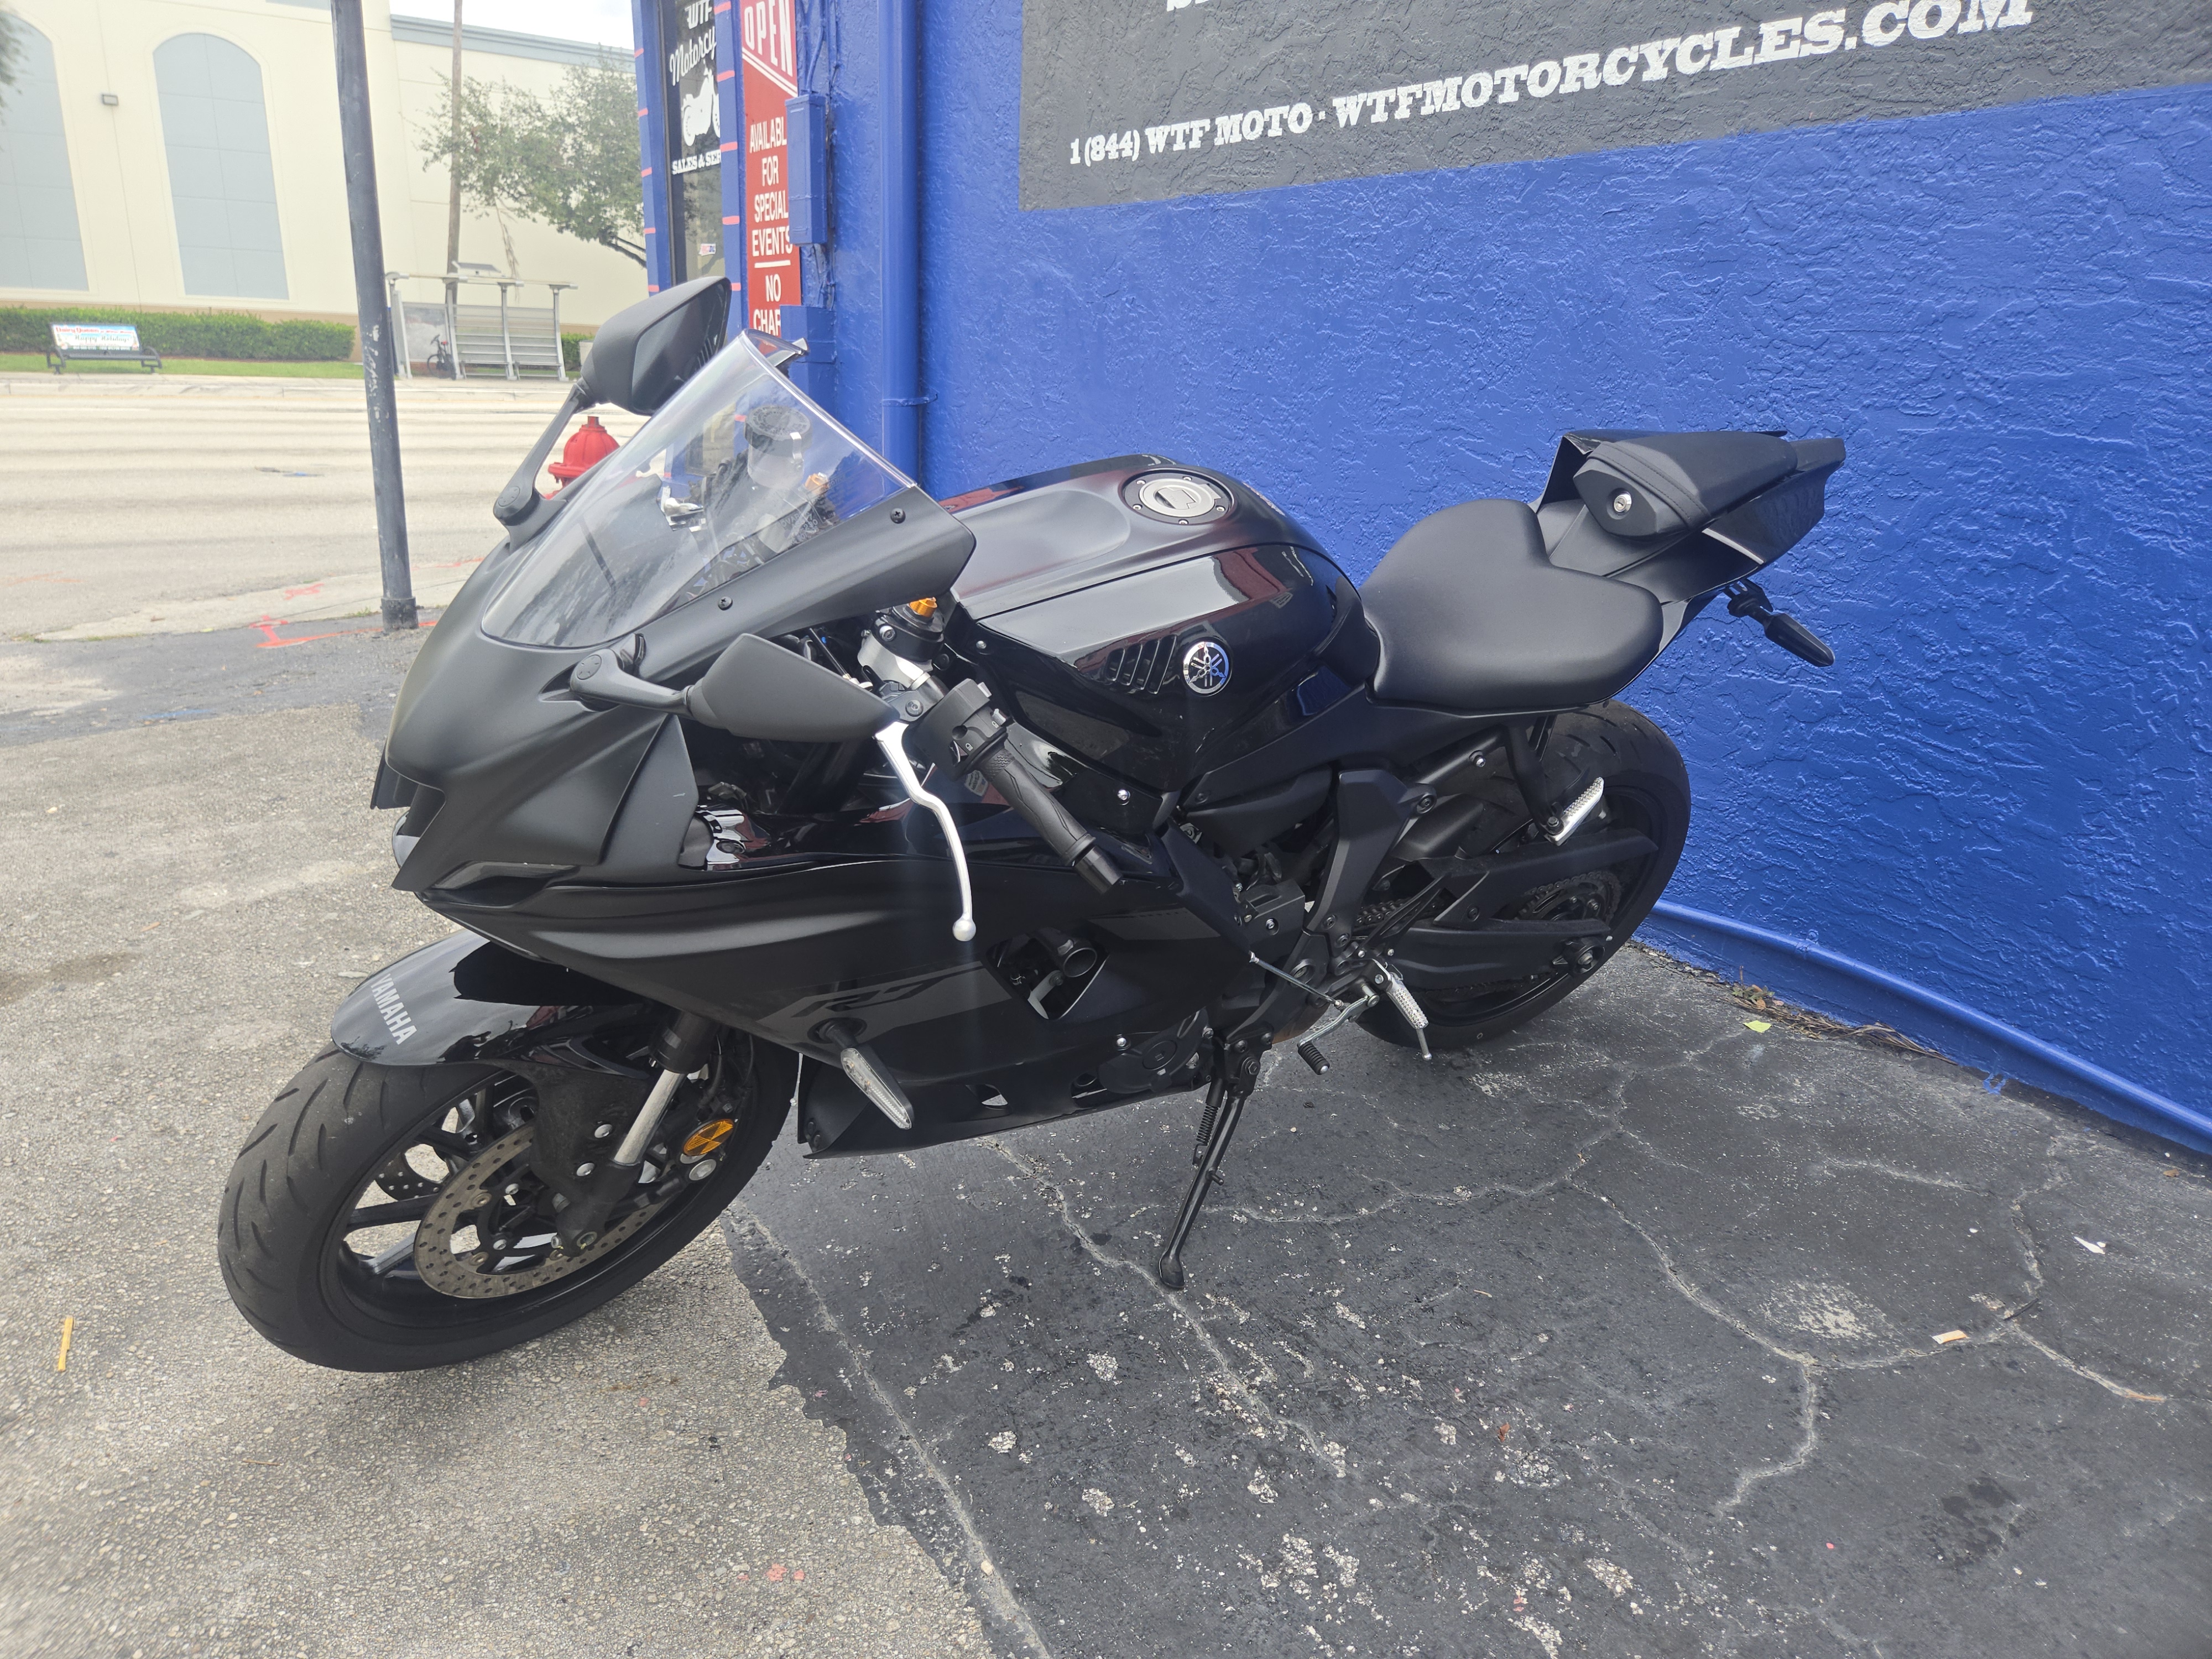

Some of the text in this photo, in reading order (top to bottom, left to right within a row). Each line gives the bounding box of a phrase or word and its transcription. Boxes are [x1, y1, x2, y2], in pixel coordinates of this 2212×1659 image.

[685, 0, 712, 29] WTF
[744, 0, 793, 77] OPEN
[1145, 119, 1211, 154] WTF
[1214, 103, 1313, 145] MOTO
[1332, 0, 2033, 128] WTFMOTORCYCLES.COM
[672, 155, 697, 175] SALES
[698, 154, 705, 169] &
[762, 155, 779, 186] FOR
[754, 190, 789, 223] SPECIAL
[752, 226, 793, 257] EVENTS
[765, 274, 781, 302] NO
[371, 973, 418, 1045] YAMAHA
